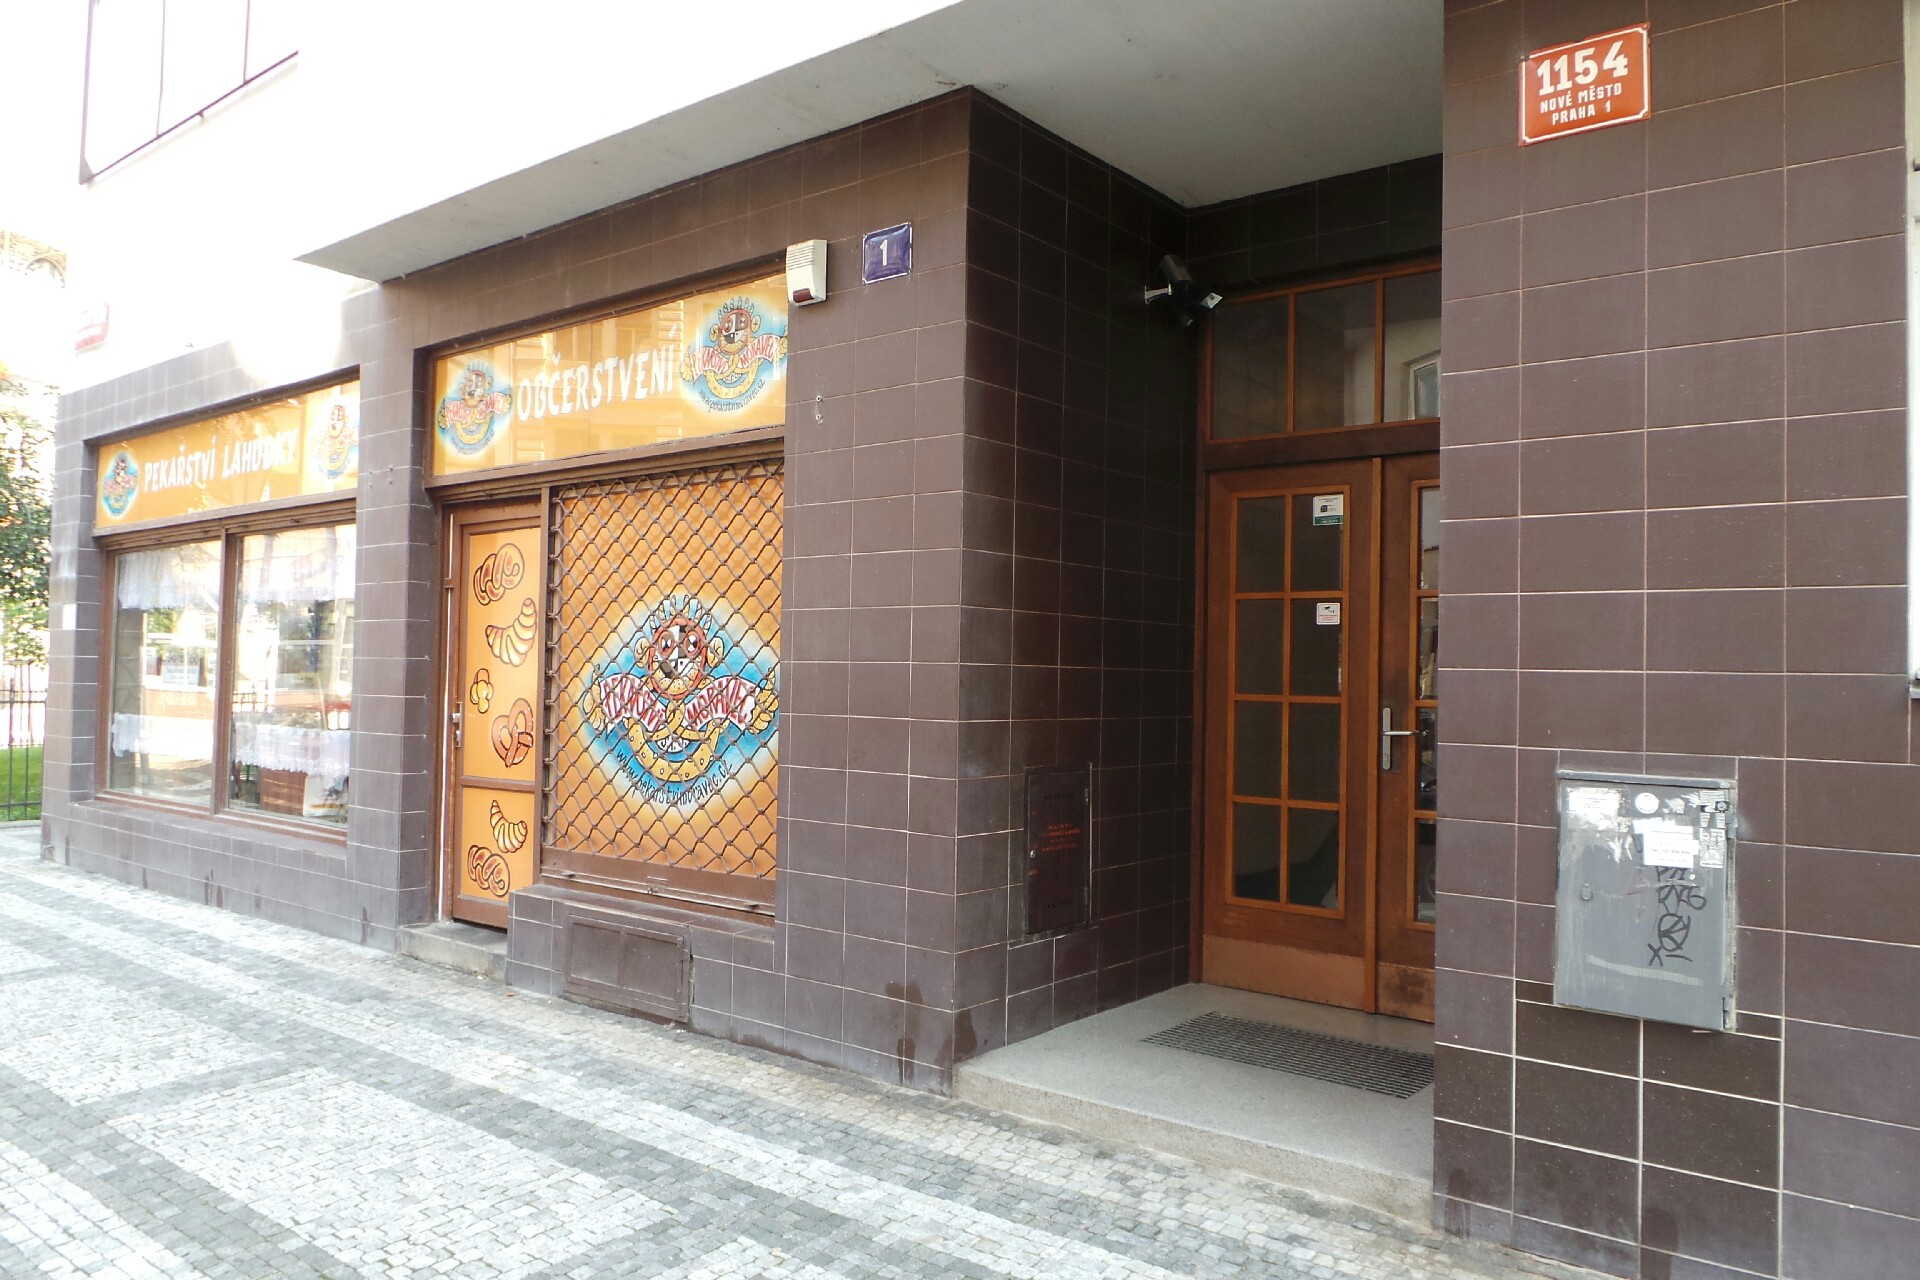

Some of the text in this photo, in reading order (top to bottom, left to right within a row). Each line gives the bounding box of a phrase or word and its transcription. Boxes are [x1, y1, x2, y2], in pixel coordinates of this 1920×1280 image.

[1537, 40, 1629, 96] 1154
[1540, 82, 1622, 113] NOVÉ MĚSTO
[1552, 100, 1612, 125] PRAHA 1
[880, 239, 888, 267] 1
[517, 323, 678, 422] OBČERSTVENÍ
[143, 434, 217, 494] PEKAŘSTVÍ
